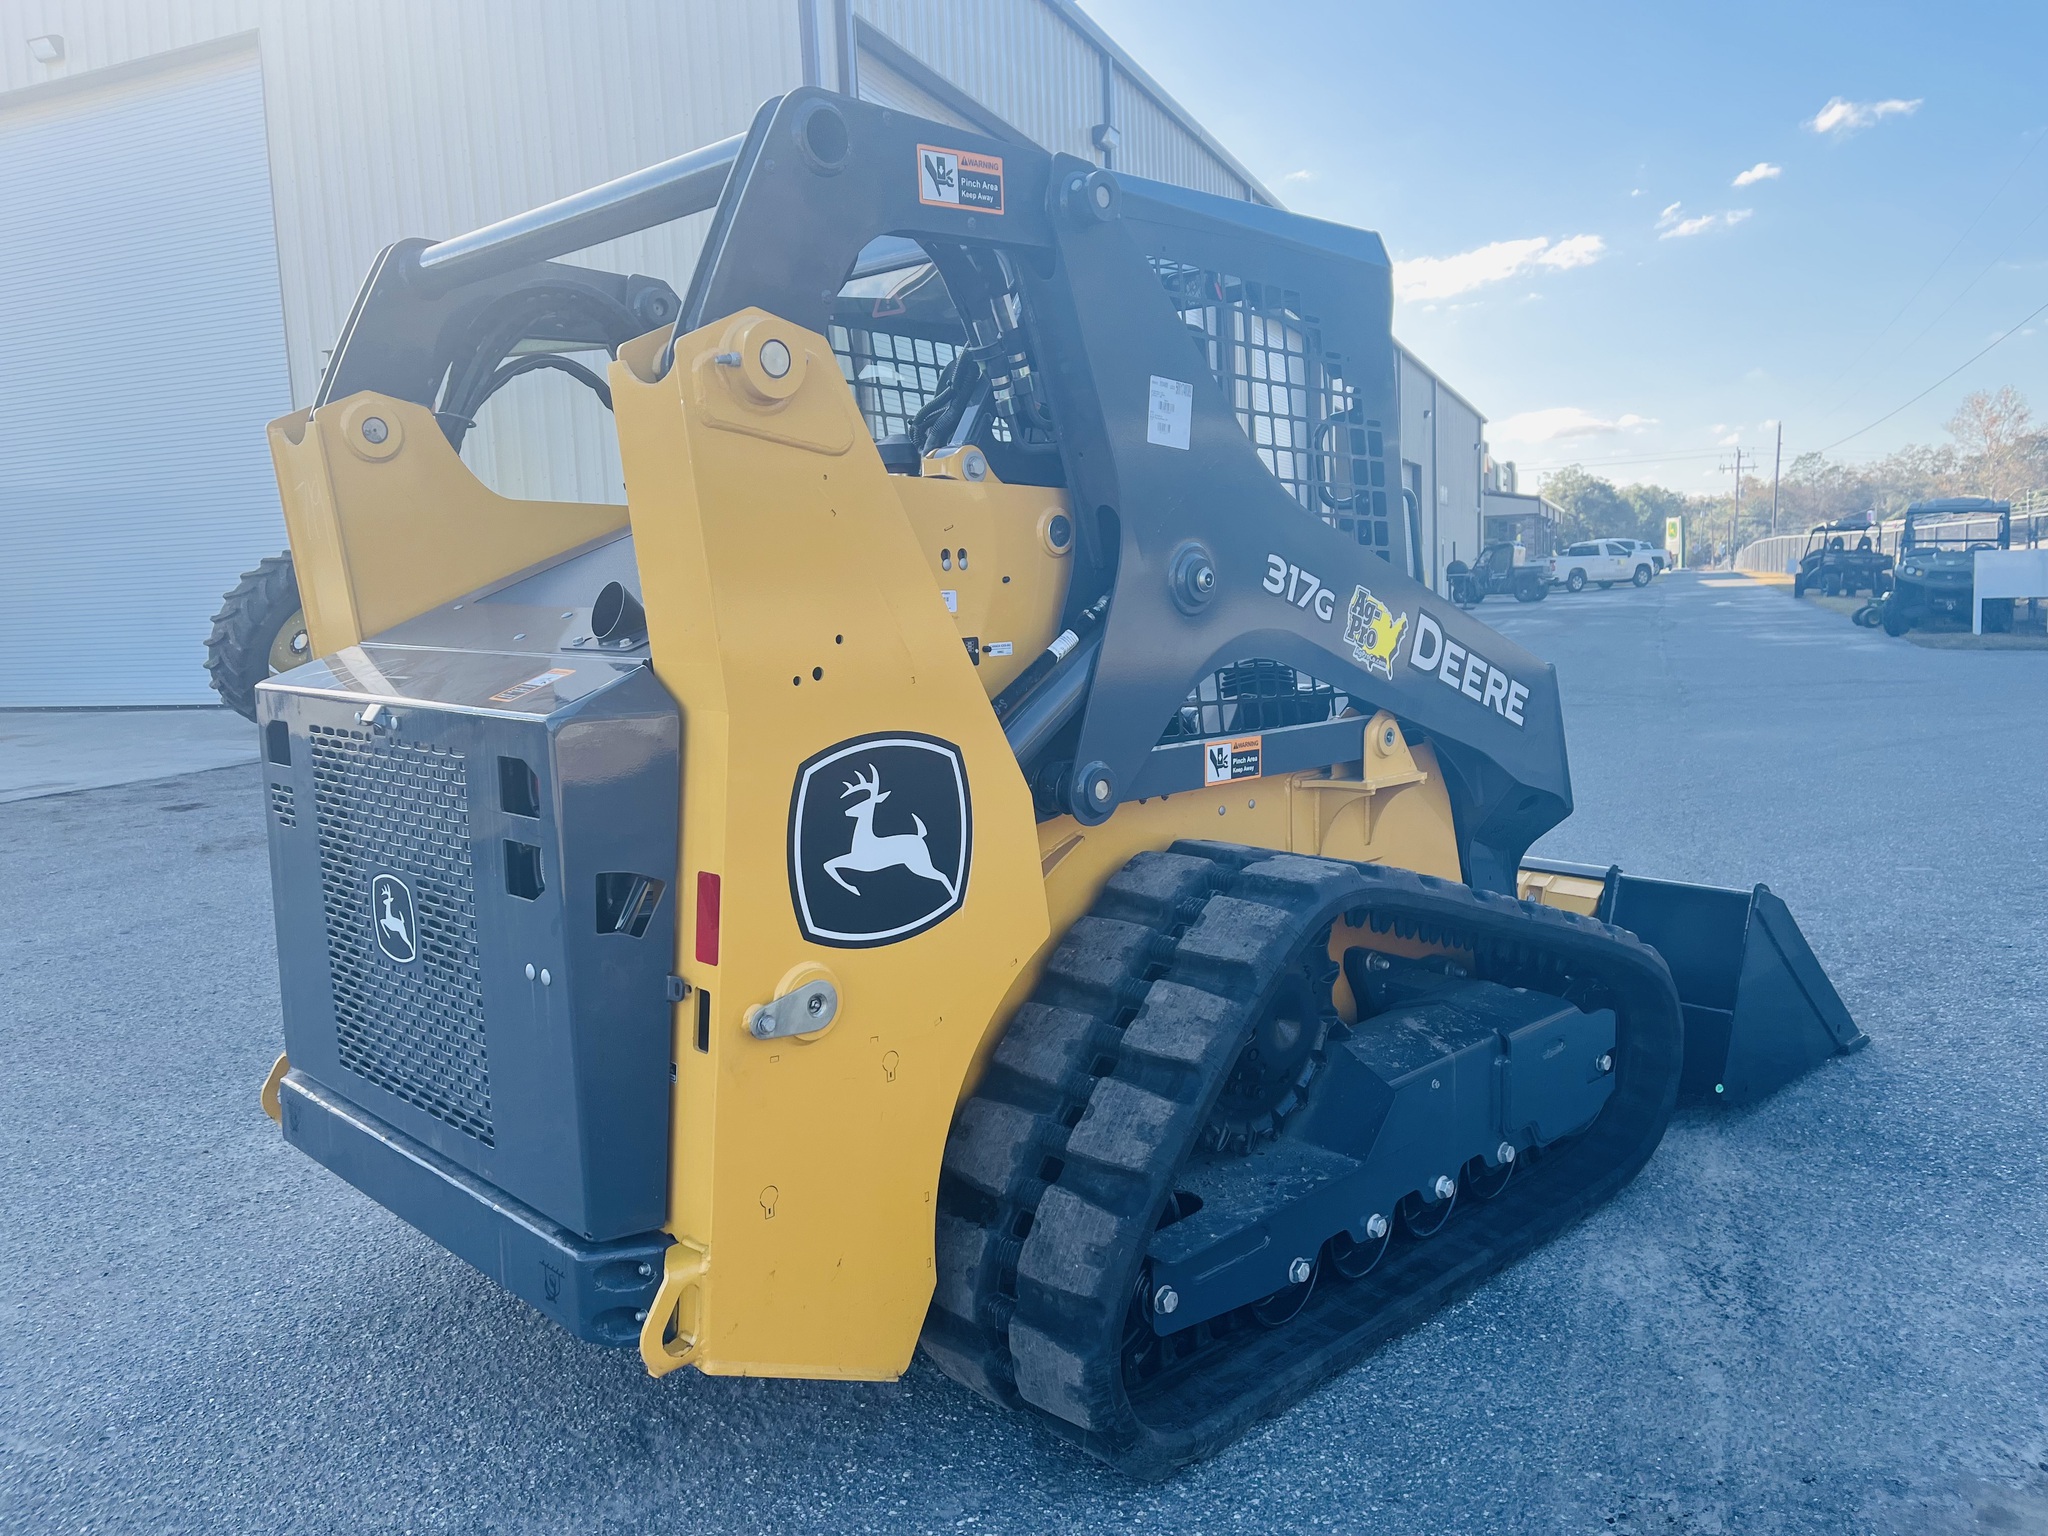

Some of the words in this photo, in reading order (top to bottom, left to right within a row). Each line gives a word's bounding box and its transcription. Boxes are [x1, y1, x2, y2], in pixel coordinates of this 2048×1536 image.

[968, 159, 999, 171] WARNING
[961, 177, 981, 189] Pinch
[982, 180, 998, 191] Area
[961, 190, 977, 200] Keep
[977, 192, 994, 203] Away
[1262, 553, 1336, 621] 317G
[1346, 614, 1377, 649] Pro
[1410, 612, 1530, 727] DEERE
[1238, 740, 1259, 748] WARNING
[1232, 757, 1246, 765] Pinch
